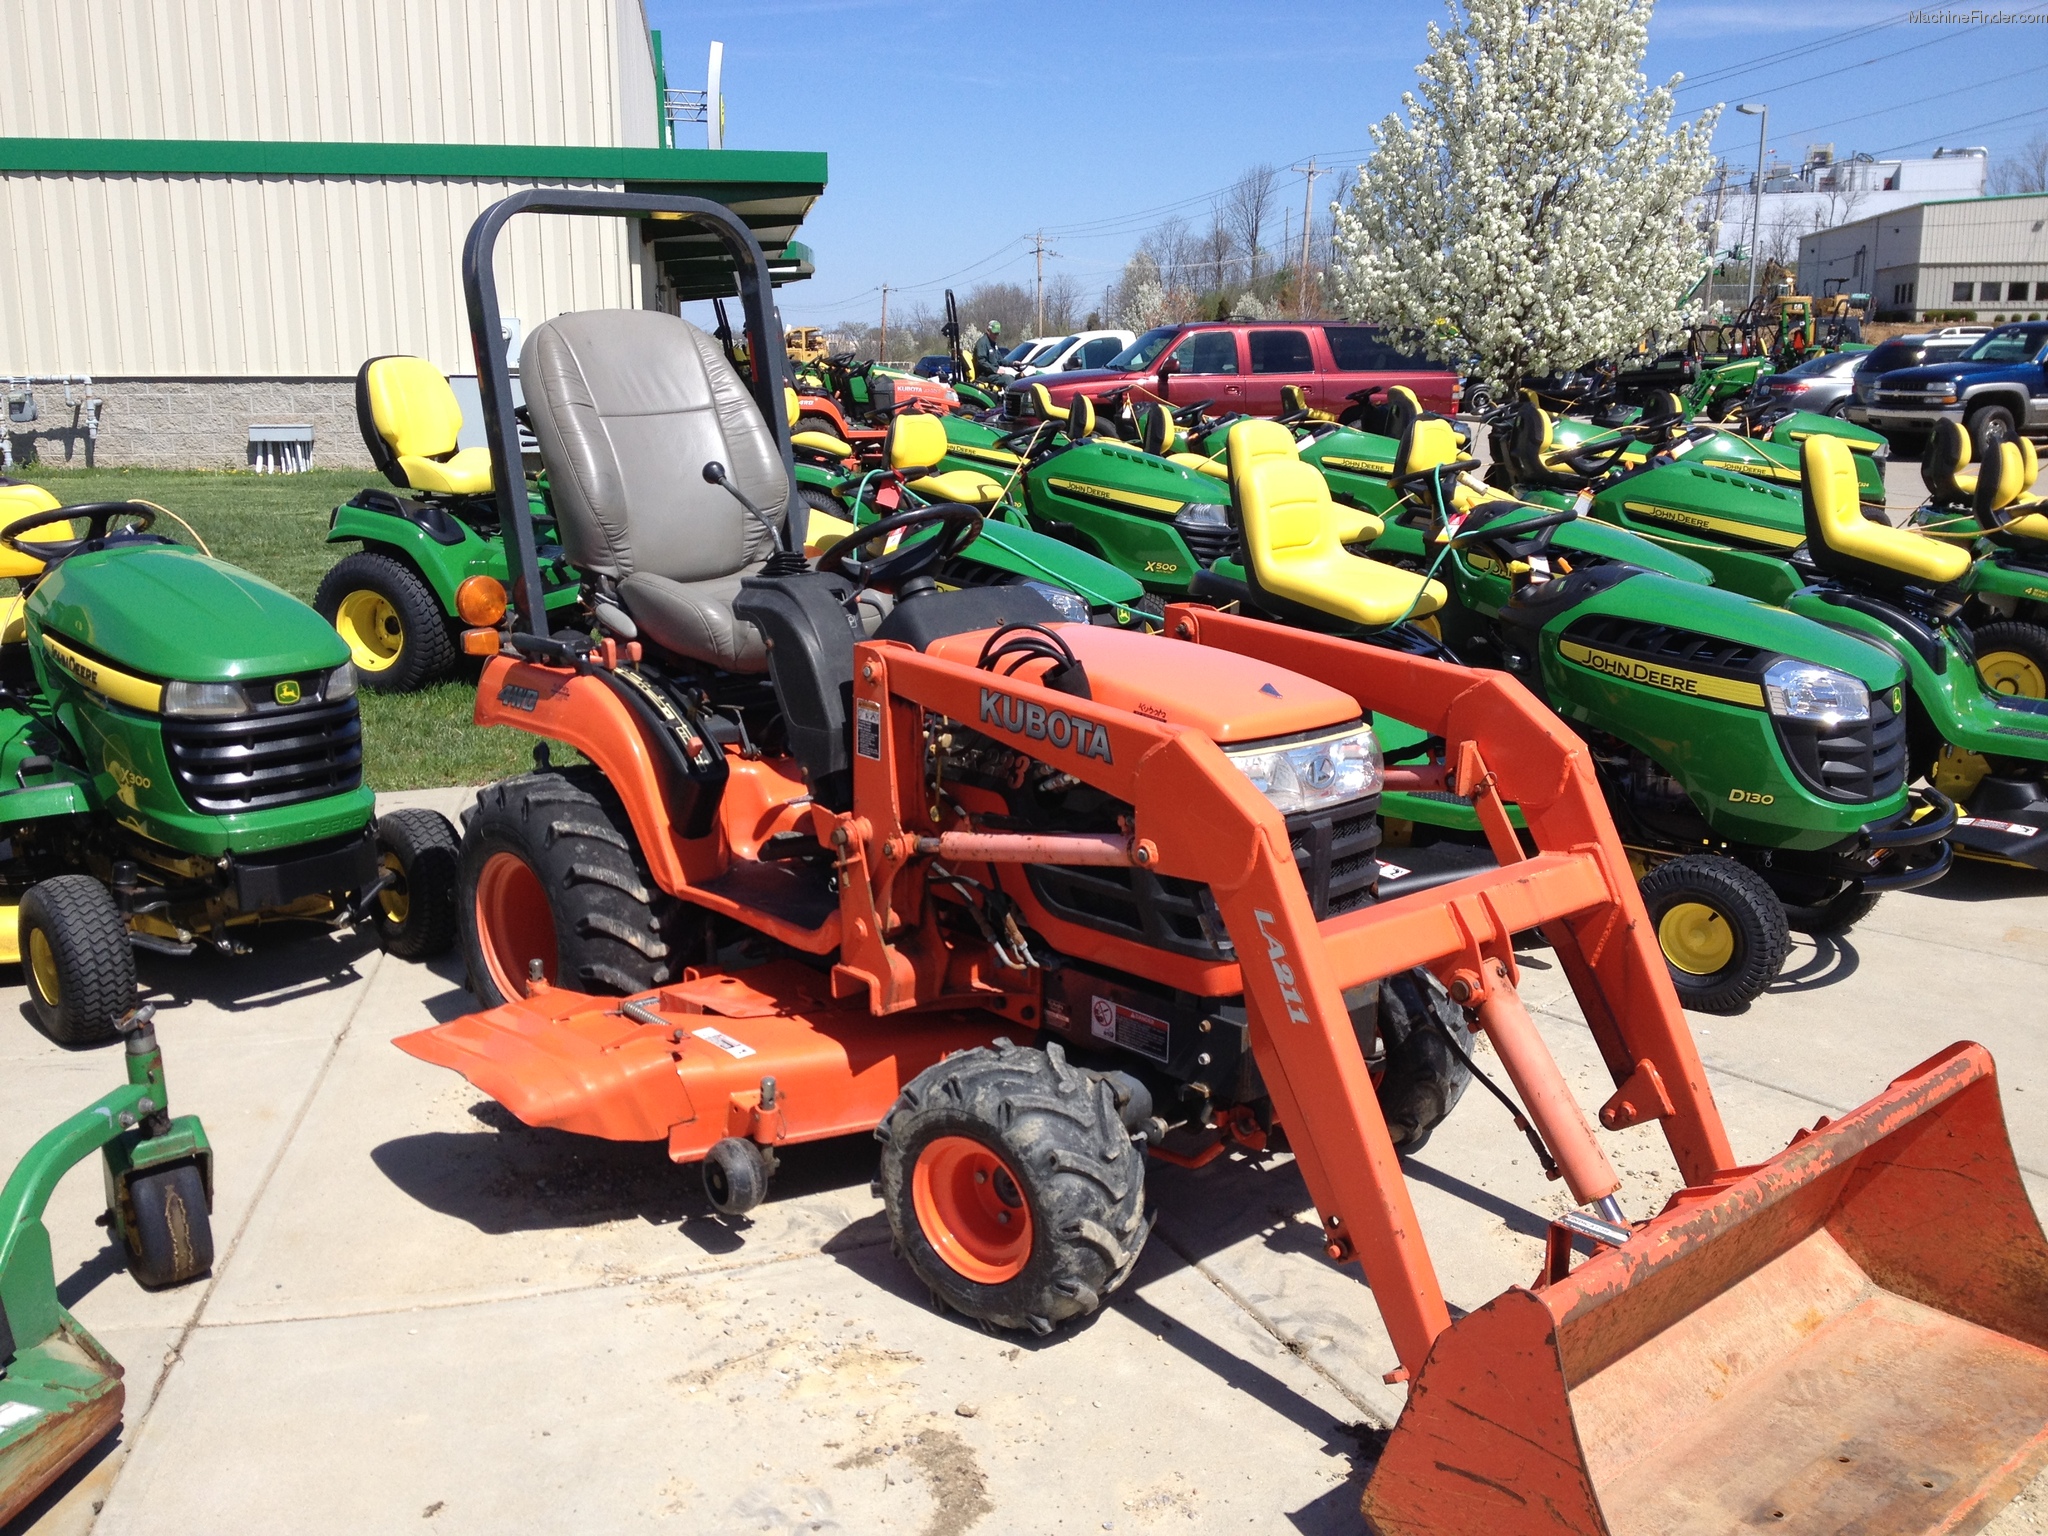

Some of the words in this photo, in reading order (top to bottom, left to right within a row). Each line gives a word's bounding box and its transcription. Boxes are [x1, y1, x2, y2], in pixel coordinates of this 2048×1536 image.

[897, 385, 923, 393] KUBOTA
[1342, 459, 1360, 468] JOHN
[1361, 461, 1385, 471] DEERE
[1722, 461, 1742, 472] JOHN
[1743, 465, 1767, 476] DEERE
[1066, 480, 1086, 492] JOHN
[1086, 485, 1111, 499] DEERE
[1649, 506, 1677, 521] JOHN
[1677, 513, 1710, 529] DEERE
[1144, 560, 1178, 572] X500
[69, 655, 98, 685] DEERE
[1582, 650, 1631, 679] JOHN
[1632, 663, 1699, 694] DEERE
[497, 683, 539, 713] 4WD
[979, 687, 1114, 766] KUBOTA
[120, 767, 151, 789] X300
[1728, 788, 1775, 806] D130
[305, 814, 363, 839] DEERE
[1253, 908, 1311, 1025] LA211
